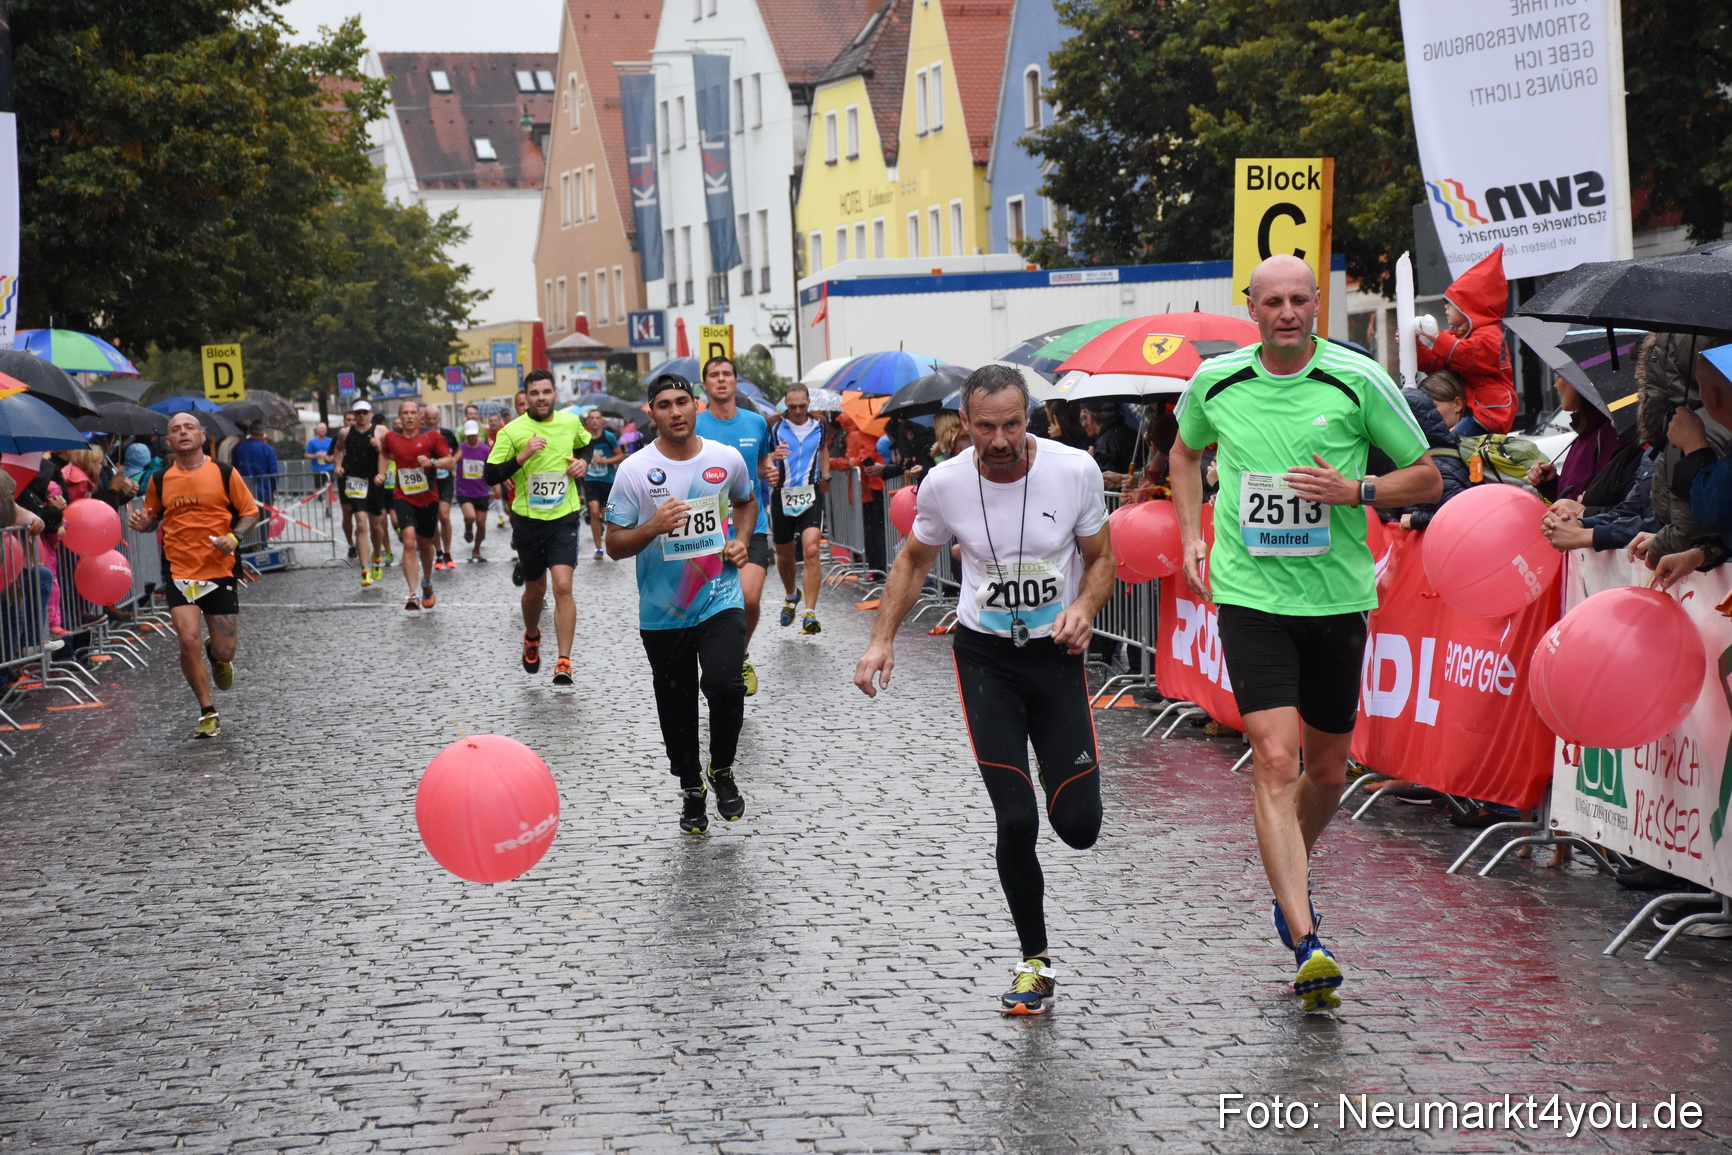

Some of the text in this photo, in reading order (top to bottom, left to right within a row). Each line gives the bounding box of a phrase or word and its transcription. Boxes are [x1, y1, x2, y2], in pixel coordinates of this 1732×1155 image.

[1247, 165, 1321, 191] Block
[1257, 202, 1307, 262] C
[703, 327, 729, 338] Block
[206, 346, 237, 358] Block
[213, 362, 234, 389] D
[404, 473, 423, 485] 298
[532, 481, 566, 496] 2572
[786, 493, 812, 507] 2752
[1249, 493, 1322, 525] 2513
[674, 538, 715, 552] Samiullah
[1260, 532, 1309, 545] Manfred
[986, 577, 1058, 608] 2005
[1633, 789, 1703, 860] BESSER
